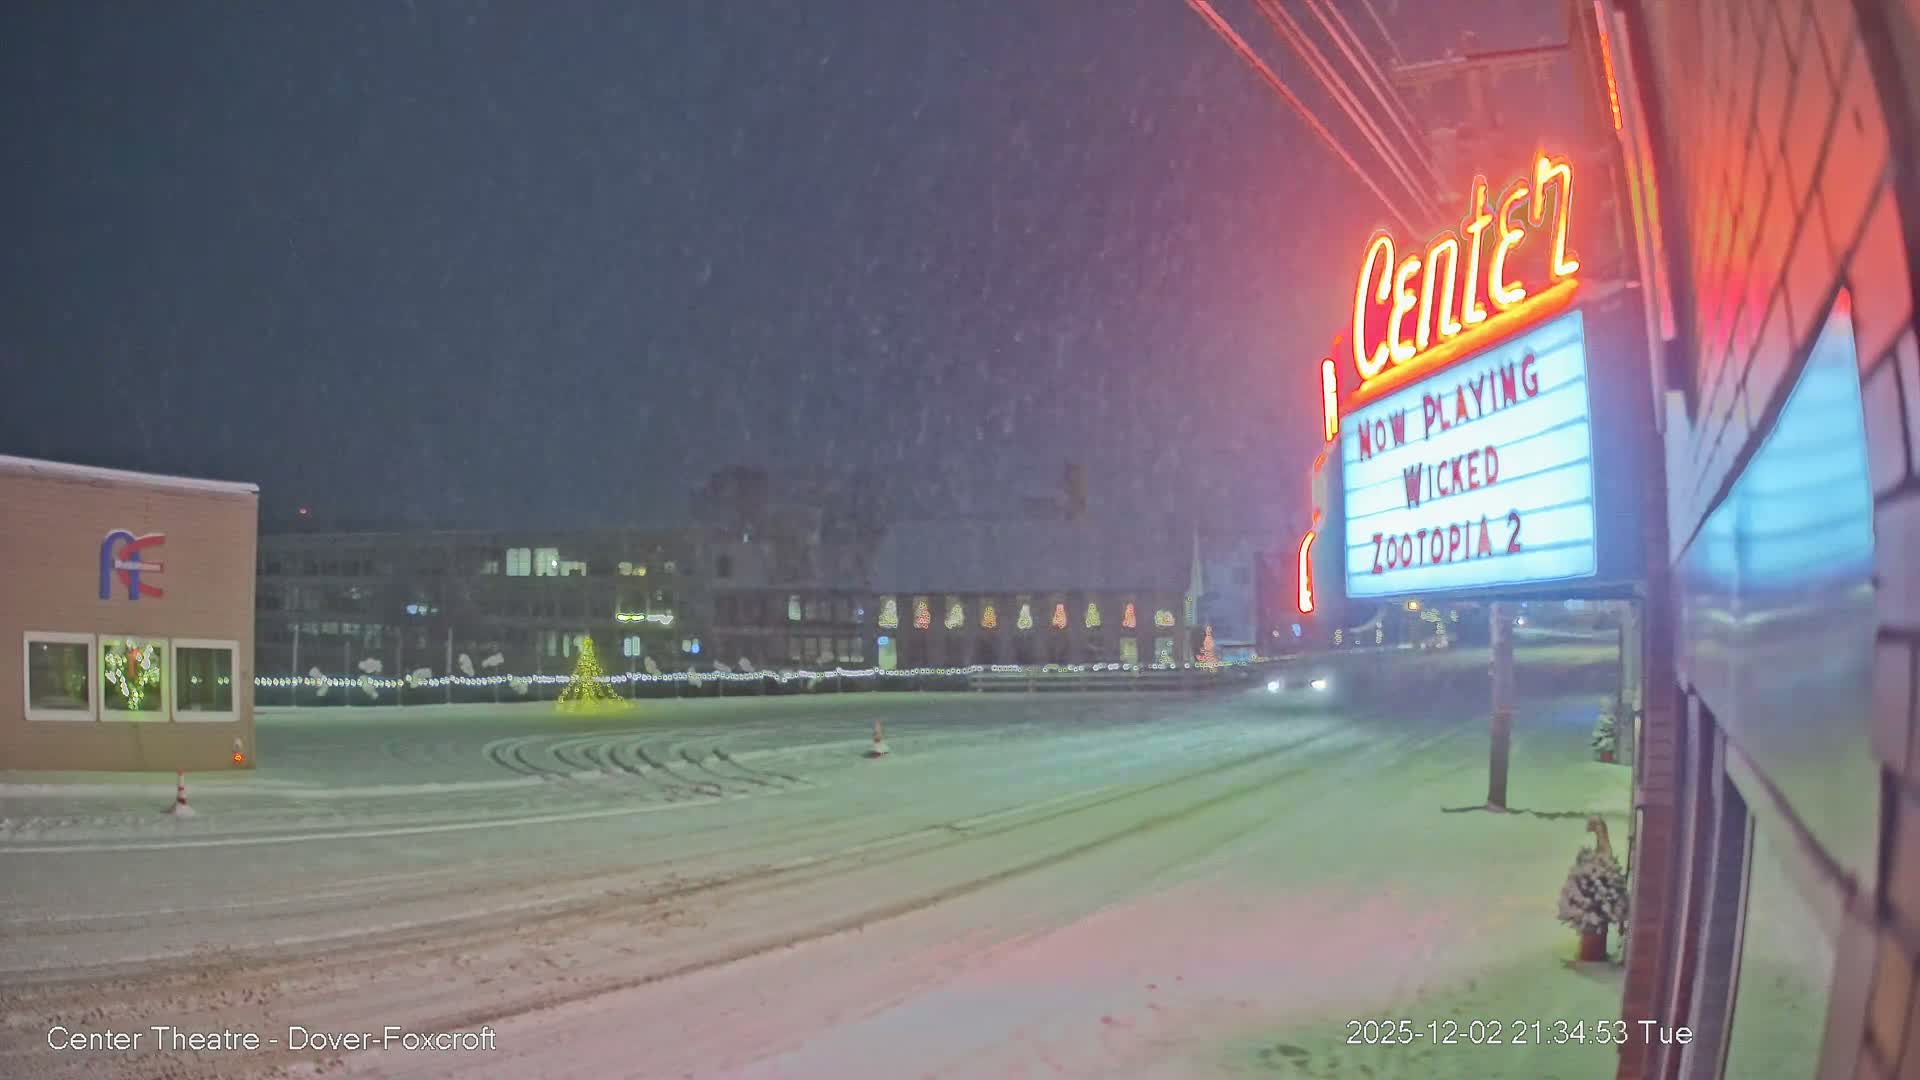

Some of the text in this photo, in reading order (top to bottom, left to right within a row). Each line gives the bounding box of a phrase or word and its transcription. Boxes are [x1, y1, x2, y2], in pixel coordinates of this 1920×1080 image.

[1358, 353, 1540, 462] NOW PLAYING
[1403, 446, 1500, 509] WICKED
[1371, 511, 1522, 575] ZOOTOPIA 2
